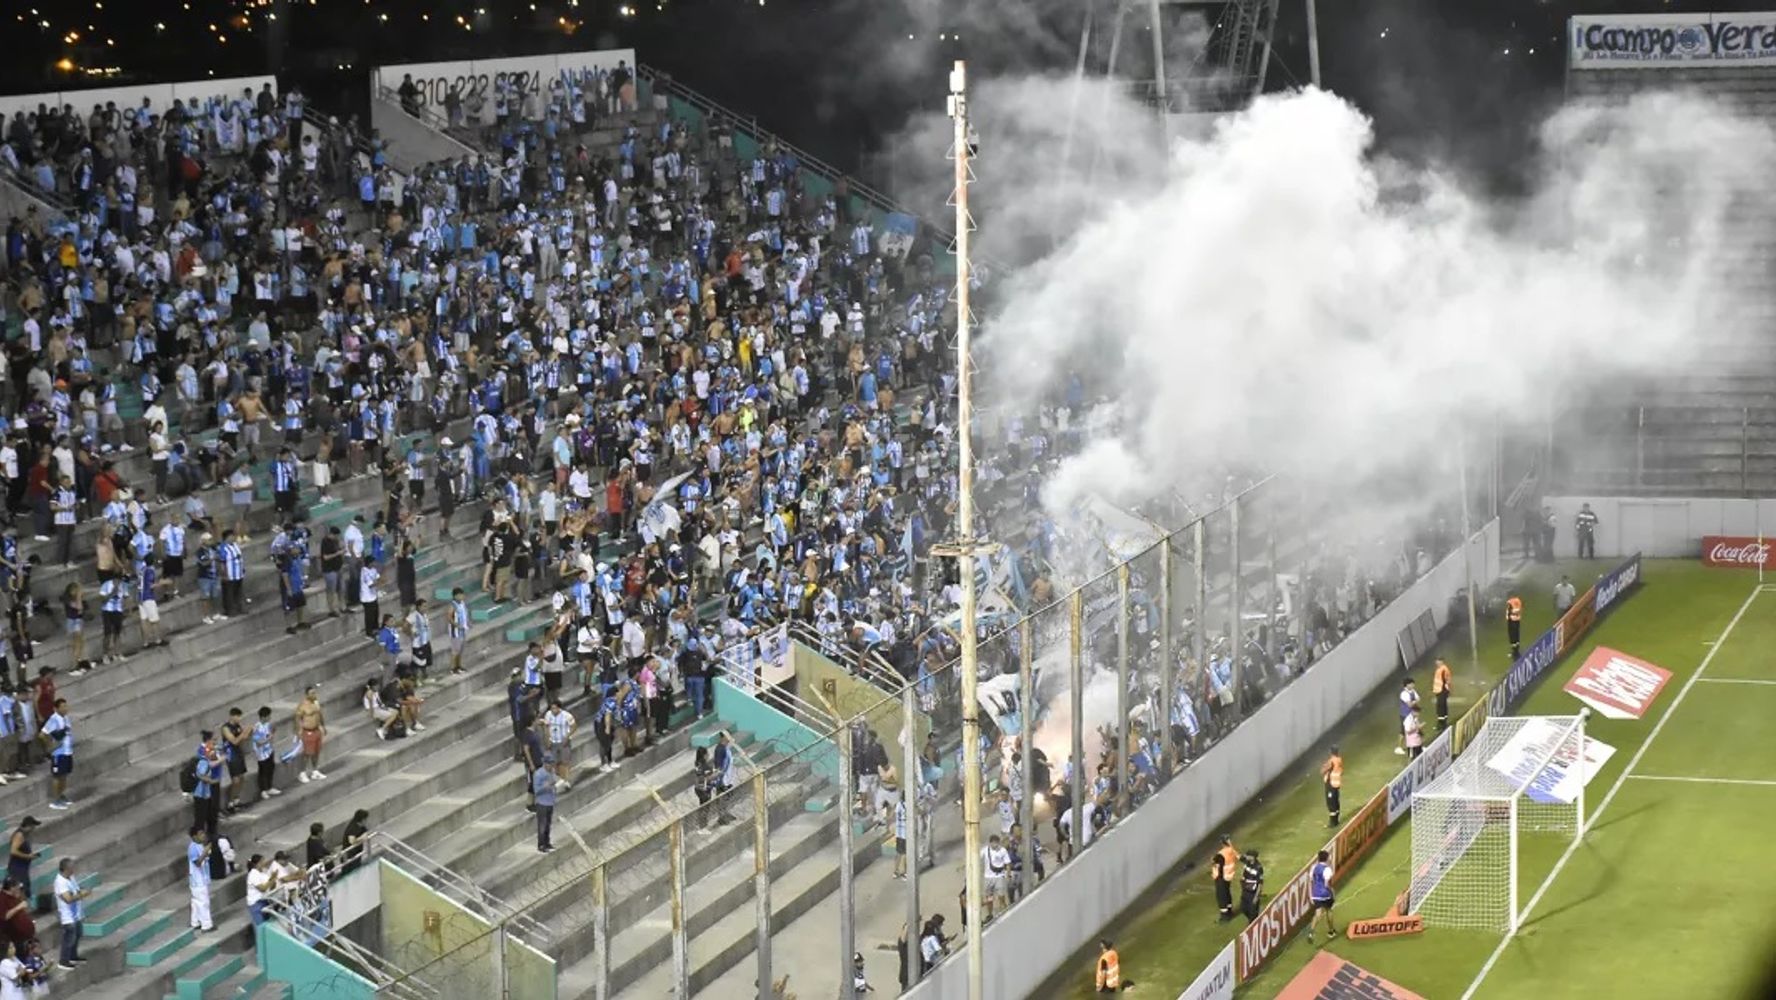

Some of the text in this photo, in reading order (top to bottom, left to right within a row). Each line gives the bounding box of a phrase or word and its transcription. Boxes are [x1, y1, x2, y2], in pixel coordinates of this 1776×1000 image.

[1585, 24, 1676, 54] Campo
[1710, 541, 1771, 564] Coca-Cola
[1239, 874, 1315, 978] MOSTAZ
